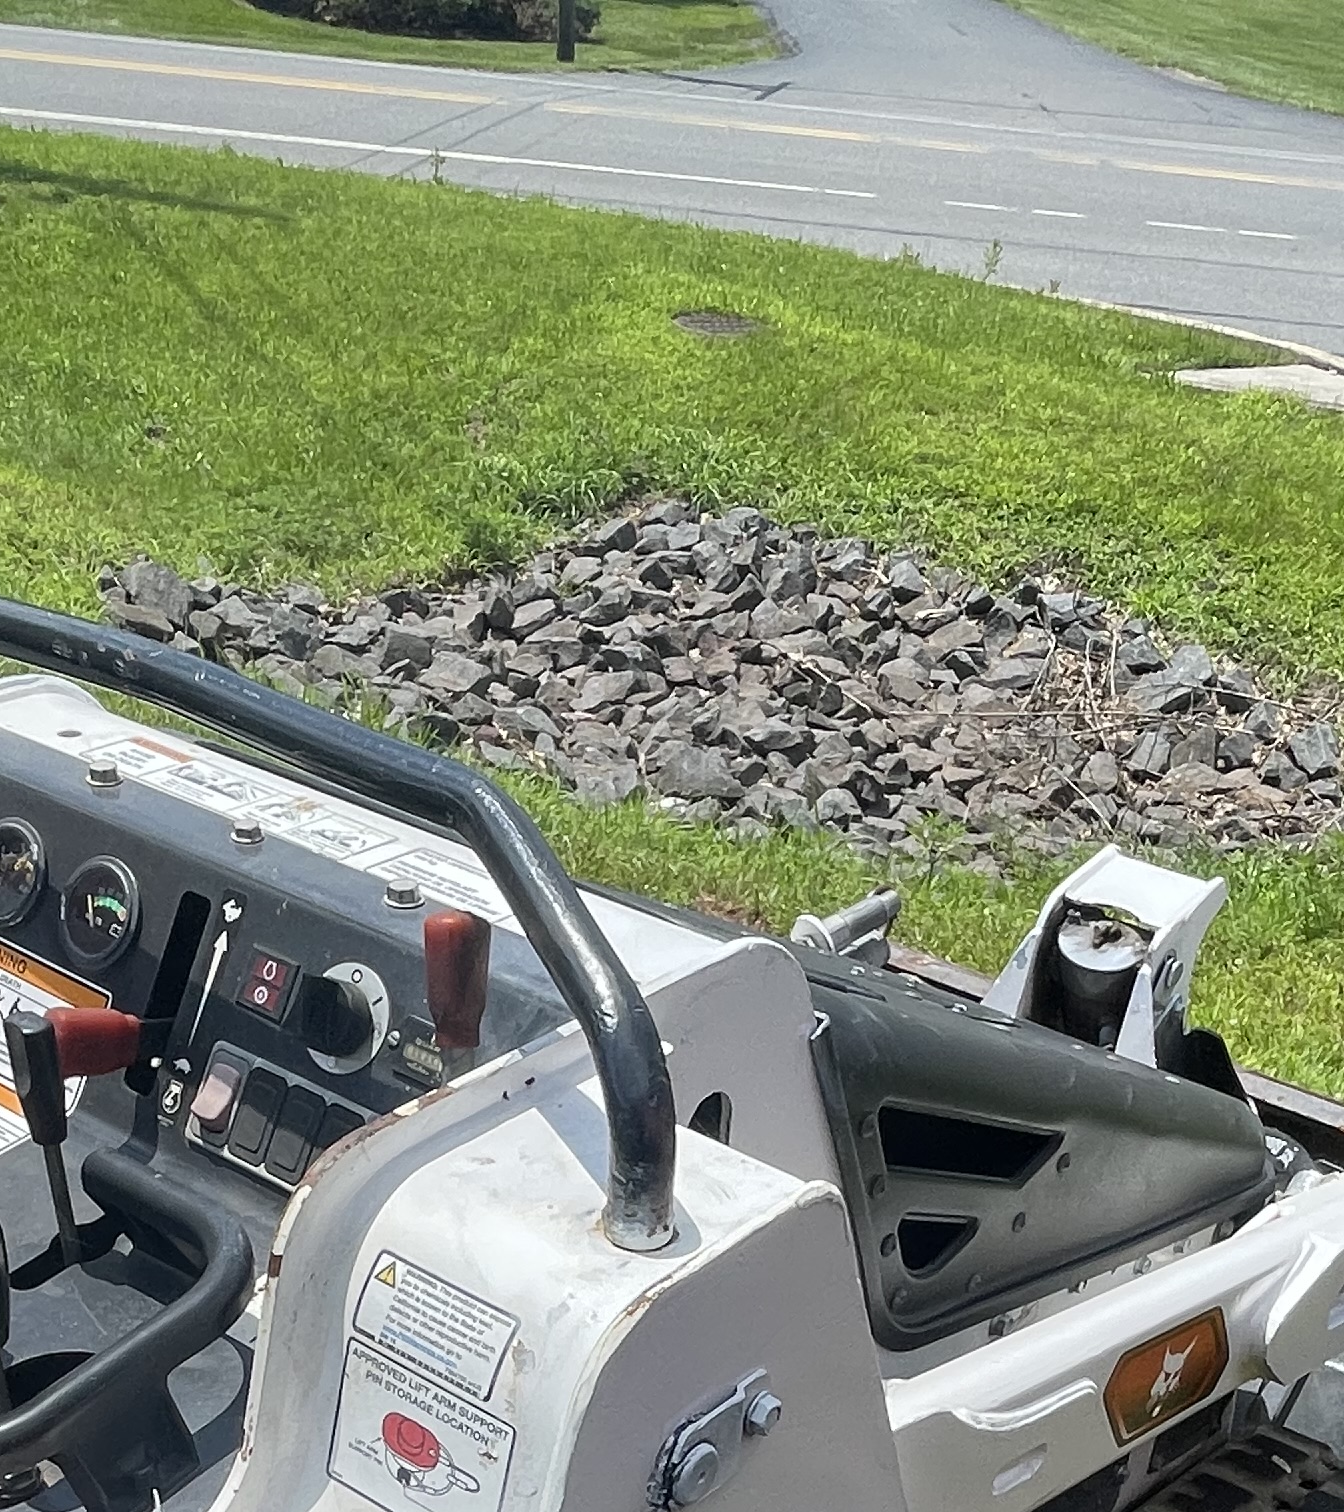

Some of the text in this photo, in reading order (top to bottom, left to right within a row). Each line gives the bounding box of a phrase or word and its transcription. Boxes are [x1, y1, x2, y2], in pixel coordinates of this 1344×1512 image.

[352, 1347, 407, 1382] APPROVED
[408, 1376, 431, 1397] LIFT
[432, 1392, 457, 1411] ARM
[458, 1406, 510, 1440] SUPPORT
[366, 1371, 490, 1447] PIN STORAGE LOCATION
